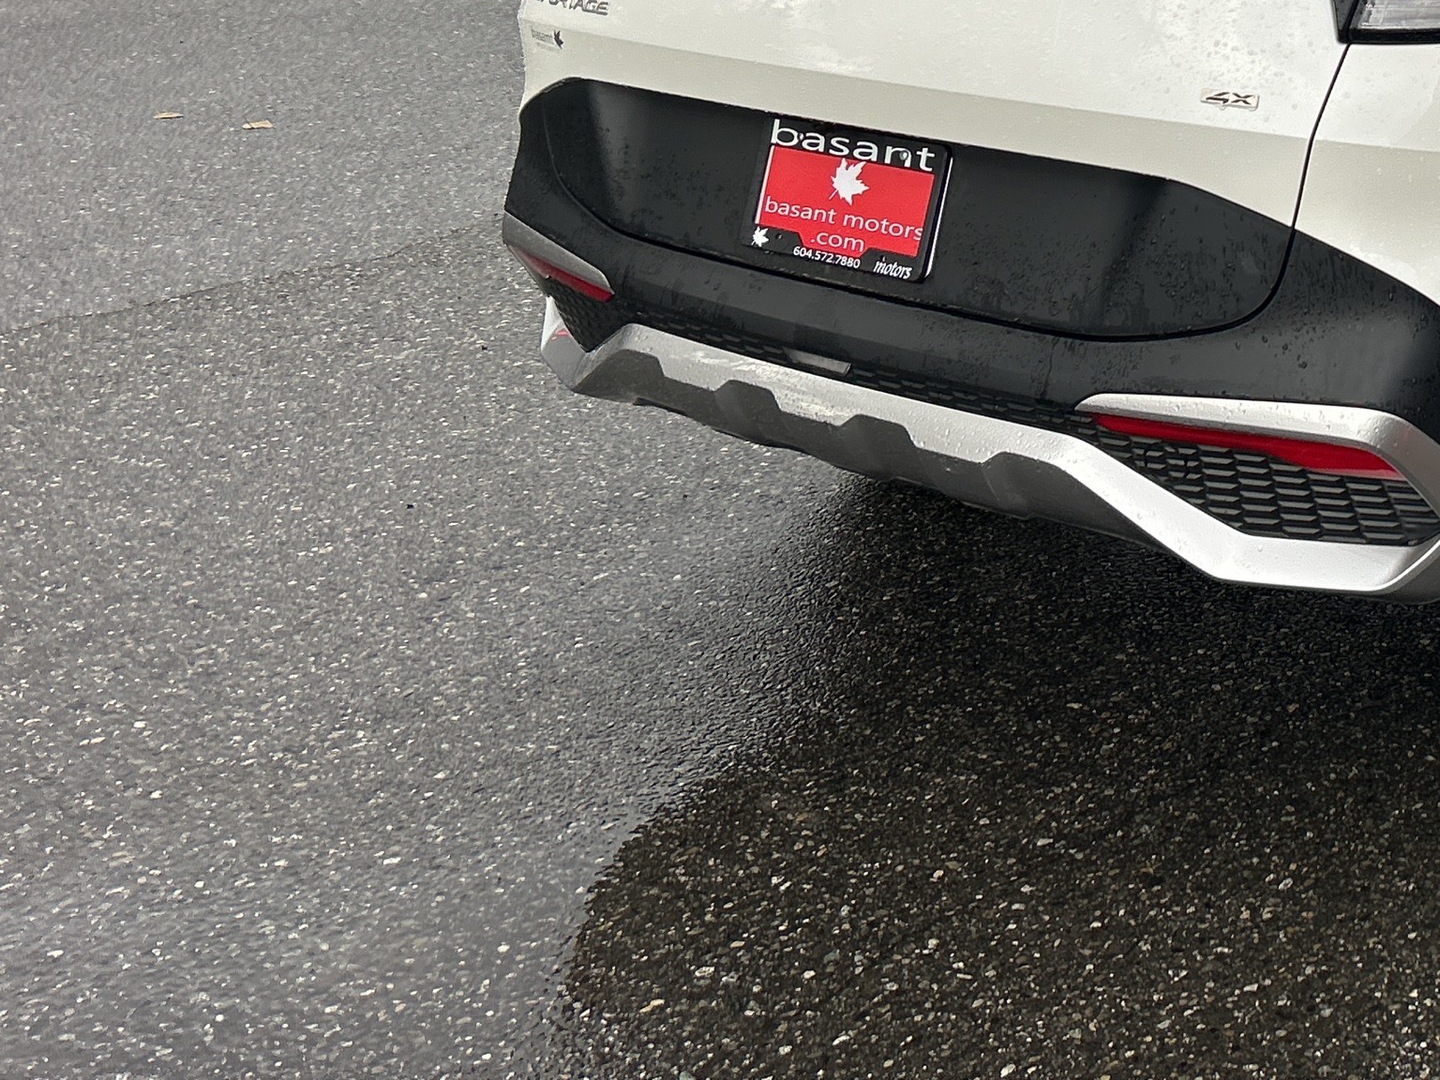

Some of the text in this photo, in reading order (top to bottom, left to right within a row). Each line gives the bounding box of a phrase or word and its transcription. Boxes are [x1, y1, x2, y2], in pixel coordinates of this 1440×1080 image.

[770, 119, 935, 171] basant
[764, 195, 924, 241] basant motors
[810, 231, 866, 253] .com
[793, 246, 861, 269] 604.572.7880
[873, 258, 912, 280] motors
